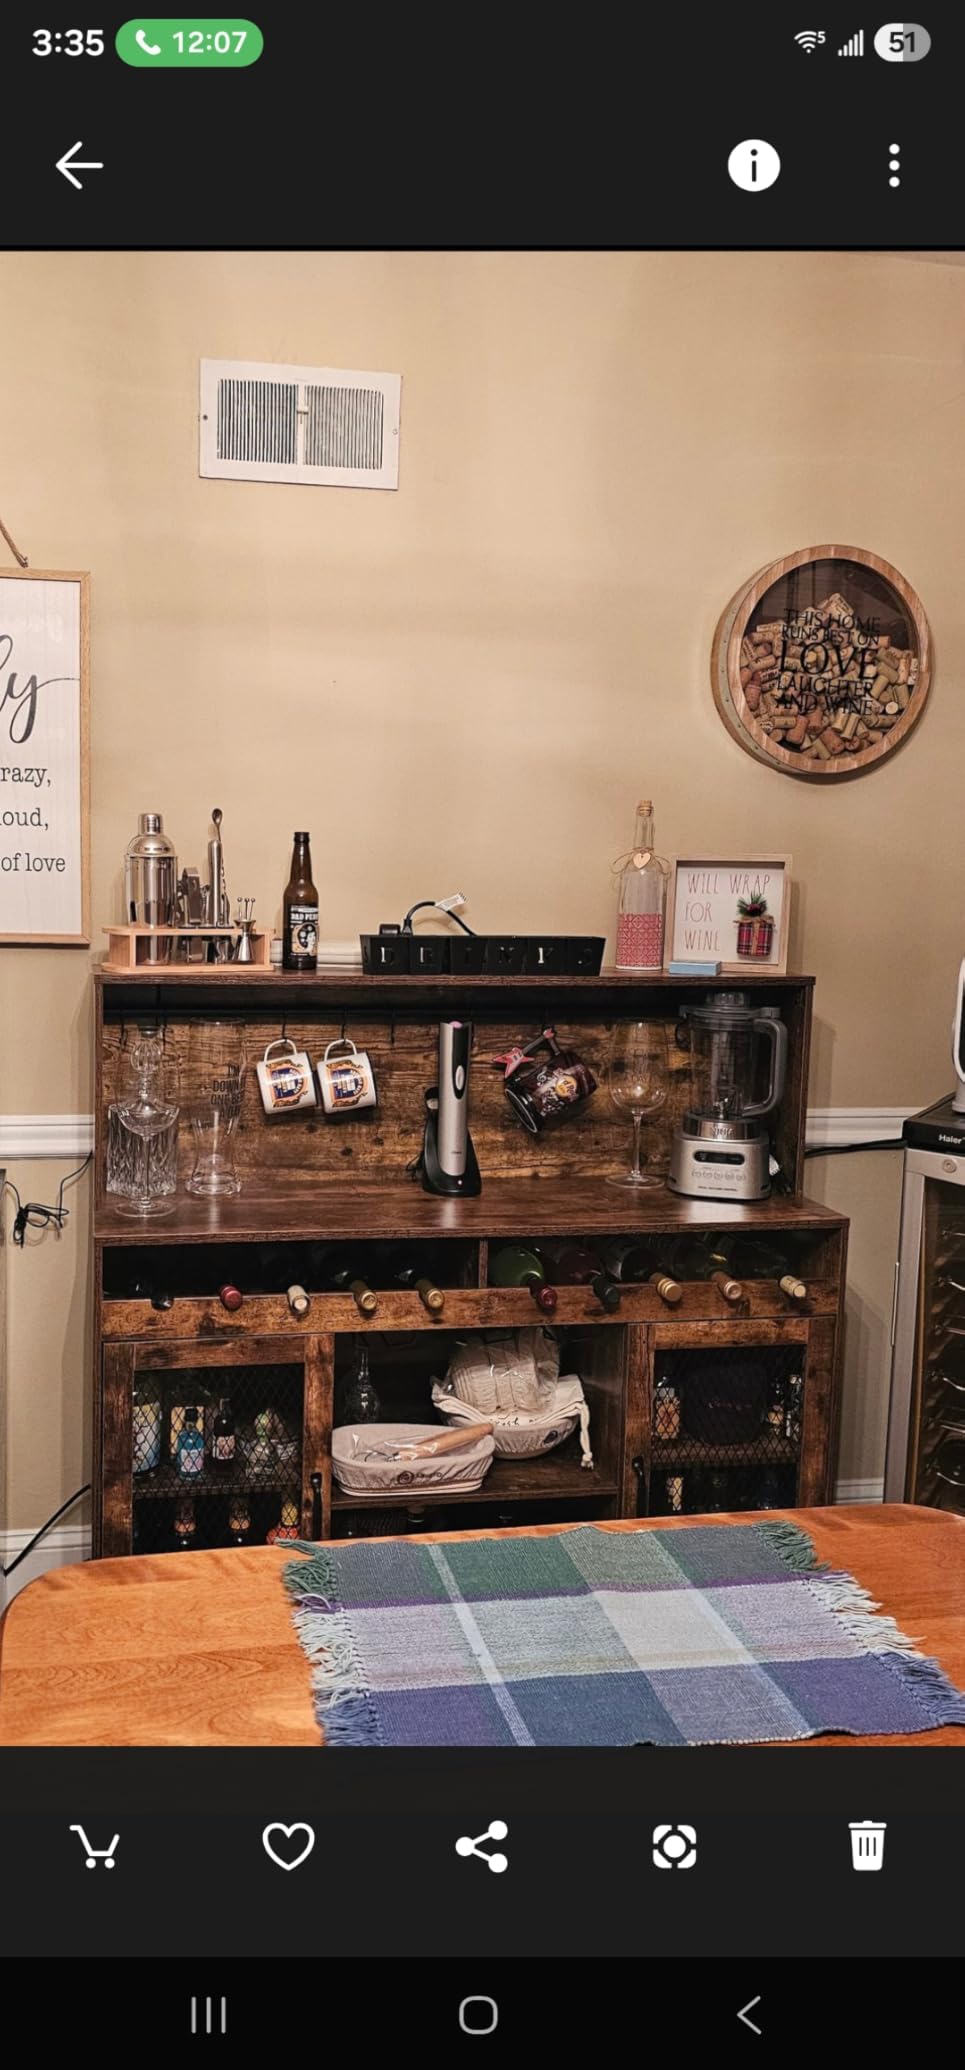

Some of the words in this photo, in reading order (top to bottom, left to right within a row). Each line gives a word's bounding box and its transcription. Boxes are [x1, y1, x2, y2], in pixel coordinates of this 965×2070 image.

[784, 608, 823, 627] THIS
[828, 613, 880, 632] HOME
[781, 624, 819, 640] RUNS
[823, 628, 852, 645] BEST
[858, 633, 879, 645] ON
[780, 639, 879, 679] LOVE
[777, 675, 875, 700] LAUGHTER
[775, 693, 818, 715] AND
[825, 696, 873, 716] WINE
[0, 766, 51, 788] razy,
[0, 807, 49, 831] oud,
[1, 852, 21, 872] of
[25, 852, 66, 872] love
[687, 873, 719, 894] WILL
[729, 873, 770, 895] WRAP
[685, 902, 712, 922] FOR
[684, 928, 720, 951] WINE
[938, 1134, 962, 1144] Haier
